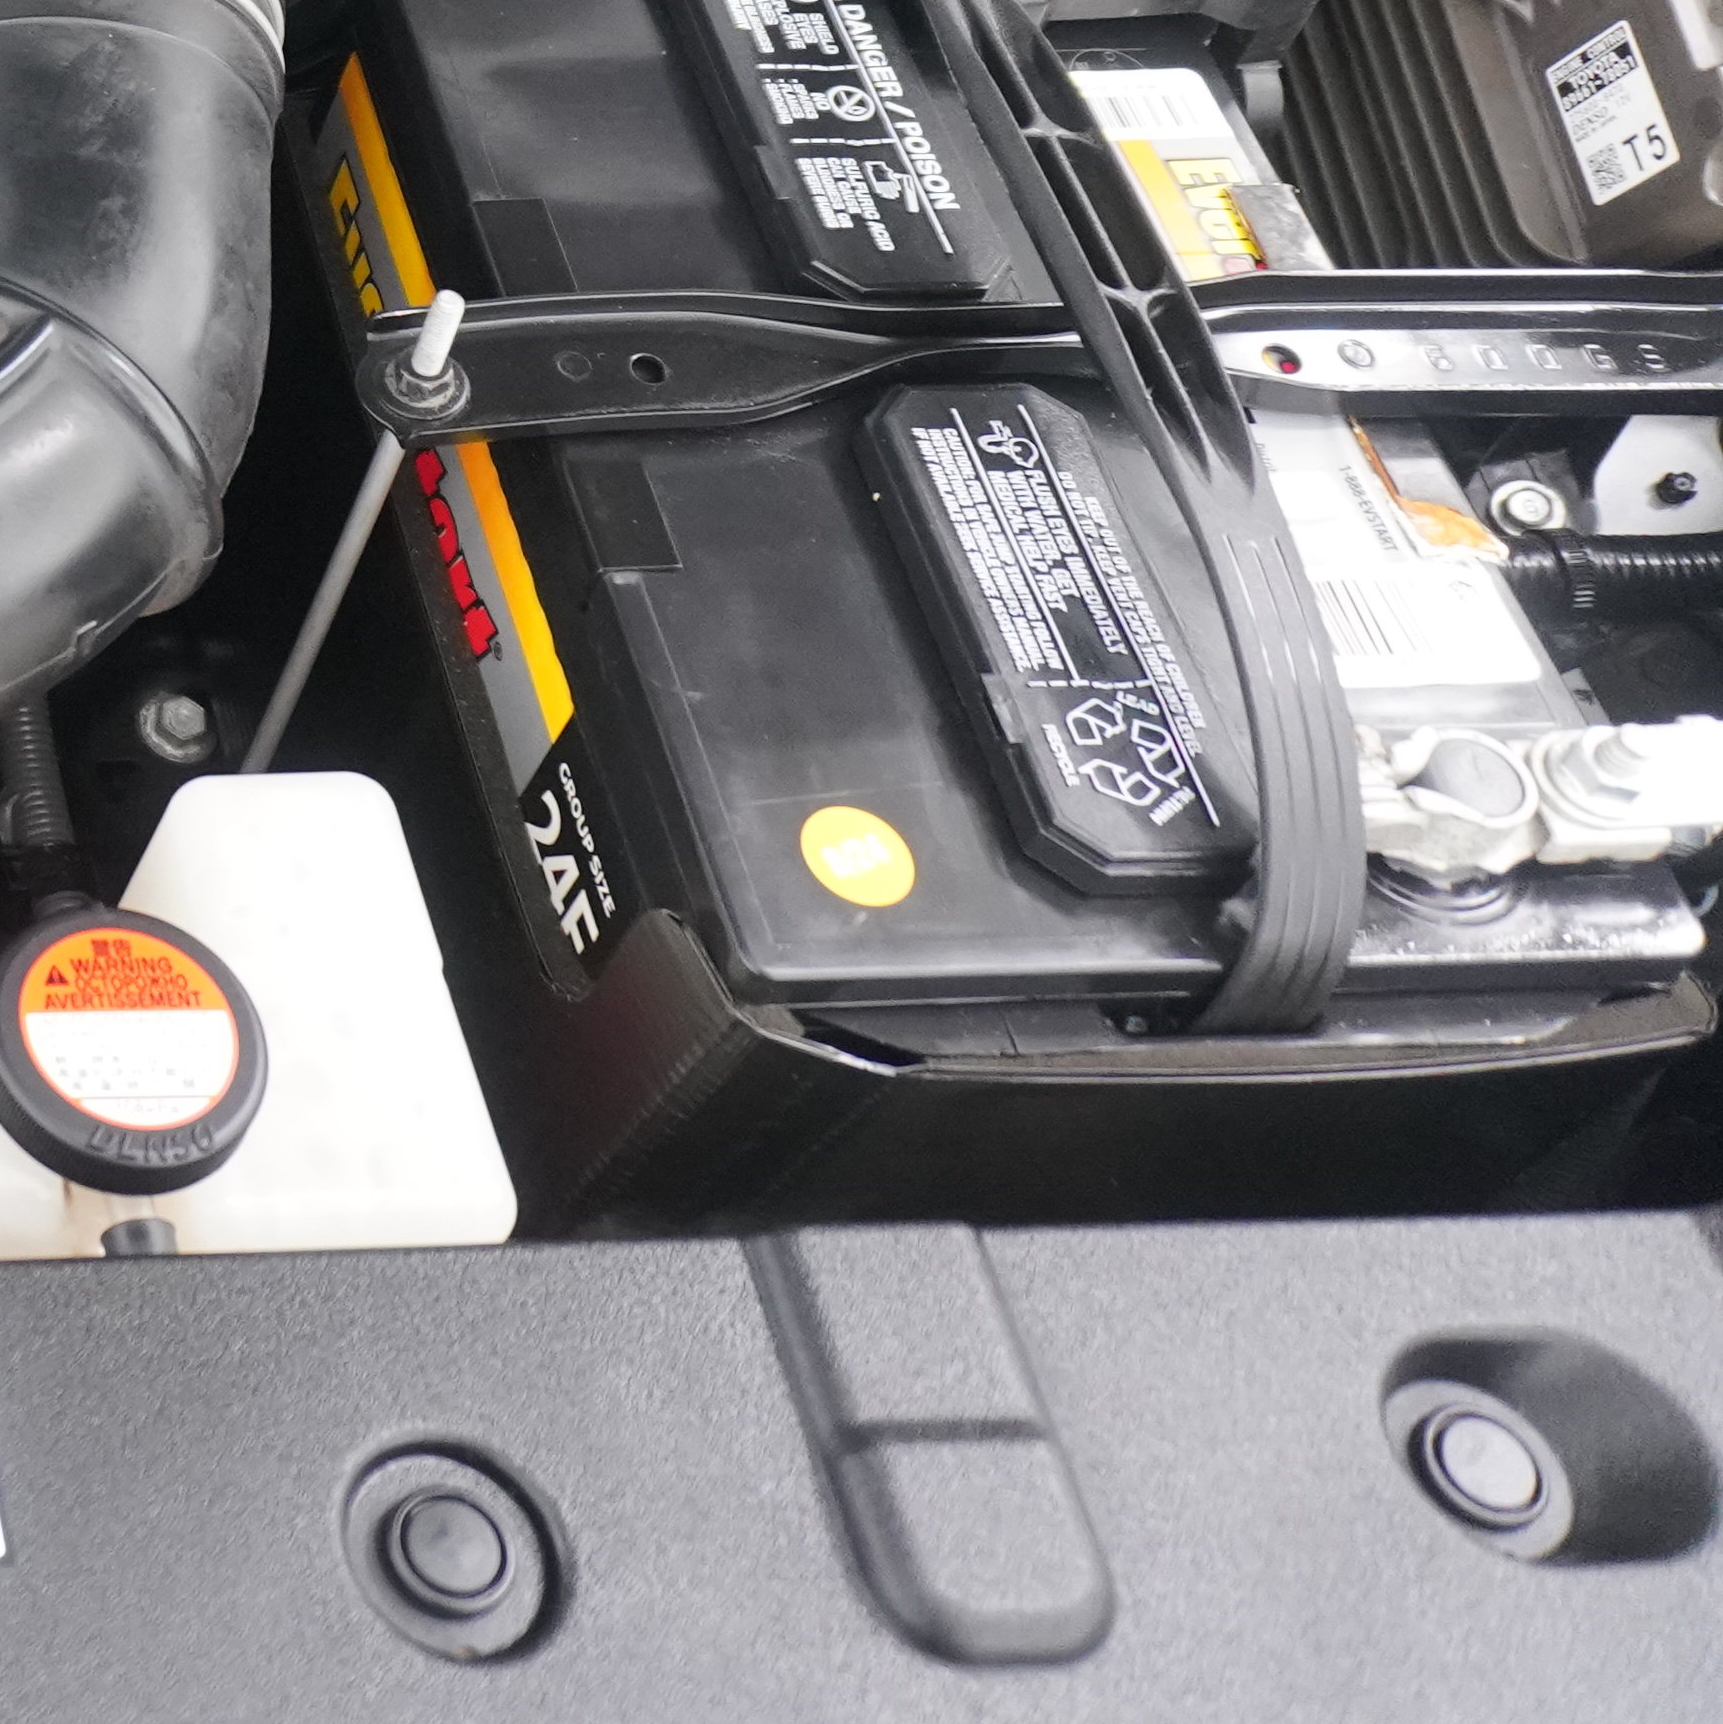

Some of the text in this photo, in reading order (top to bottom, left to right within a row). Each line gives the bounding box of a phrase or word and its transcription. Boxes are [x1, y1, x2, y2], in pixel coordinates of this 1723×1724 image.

[792, 12, 819, 43] EYES
[807, 12, 840, 55] SHIELD
[1567, 49, 1620, 92] TOYOTA
[809, 92, 831, 111] NO
[835, 3, 961, 210] DANGER / POISON
[810, 157, 855, 228] BLINDNESS OR
[825, 157, 863, 213] CAN CAUSE
[838, 158, 897, 251] SULFURIC ACID
[915, 439, 940, 463] NOT
[925, 428, 975, 507] INSTRUCTIONS
[967, 521, 1002, 567] VEHICLE
[926, 462, 966, 522] AVAILABLE
[964, 479, 990, 503] FOR
[1056, 471, 1079, 489] DO
[975, 503, 1003, 533] SAFE
[1065, 490, 1092, 517] NOT
[1082, 495, 1110, 526] KEEP
[1338, 463, 1399, 554] 1-888-EVSTART
[952, 522, 979, 551] SEEK
[985, 470, 1069, 612] MEDICAL HELP FAST
[1003, 469, 1040, 508] WITH
[1049, 567, 1081, 598] GET
[1098, 528, 1123, 554] OUT
[965, 551, 1000, 598] SERVICE
[1023, 469, 1128, 654] FLUSH EYES IMMEDIATELY
[1091, 544, 1119, 575] KEEP
[1111, 555, 1132, 572] OF
[1003, 565, 1042, 619] STARTING
[1106, 576, 1135, 609] VENT
[1120, 575, 1145, 599] THE
[1122, 610, 1151, 643] CAPS
[1133, 601, 1165, 641] REACH
[1028, 620, 1065, 670] FOLLOW
[1152, 643, 1174, 661] OF
[1138, 646, 1171, 684] TIGHT
[1114, 690, 1161, 716] LEAD
[1156, 684, 1184, 714] AND
[1041, 723, 1080, 787] RECYCLE
[558, 761, 616, 919] GROUP SIZE
[524, 788, 601, 956] 24F
[68, 956, 174, 976] WARNING
[43, 989, 203, 1010] AVERTISSEMENT
[85, 1124, 215, 1165] DENSO
